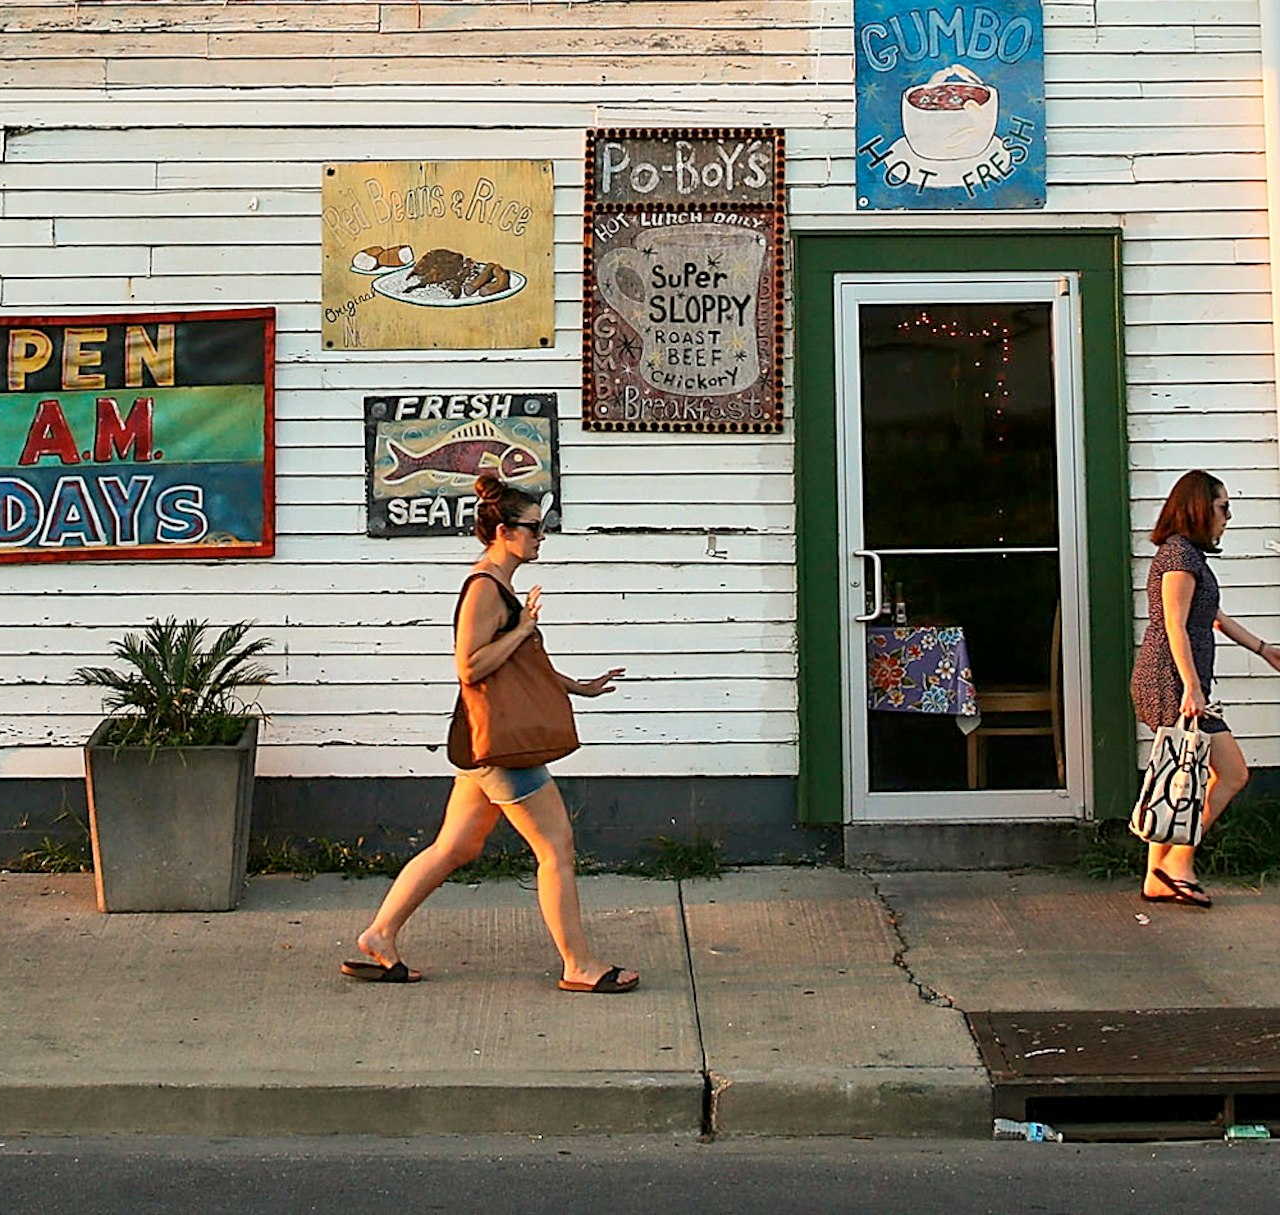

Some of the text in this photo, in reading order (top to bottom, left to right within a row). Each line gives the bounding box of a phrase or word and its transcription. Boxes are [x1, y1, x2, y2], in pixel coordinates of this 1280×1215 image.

[860, 6, 1033, 72] GUMBO
[858, 117, 1035, 198] HOT FRESH
[365, 177, 446, 226] Beans
[465, 177, 534, 237] Rice
[595, 211, 764, 243] HOT LUNCH DAILY
[648, 295, 751, 327] SLOPPY
[654, 330, 722, 346] ROAST
[593, 312, 617, 420] GUMBO
[668, 348, 723, 367] BEEF
[394, 394, 513, 421] FRESH
[623, 385, 765, 421] Breakfast
[19, 397, 164, 466] A.M.
